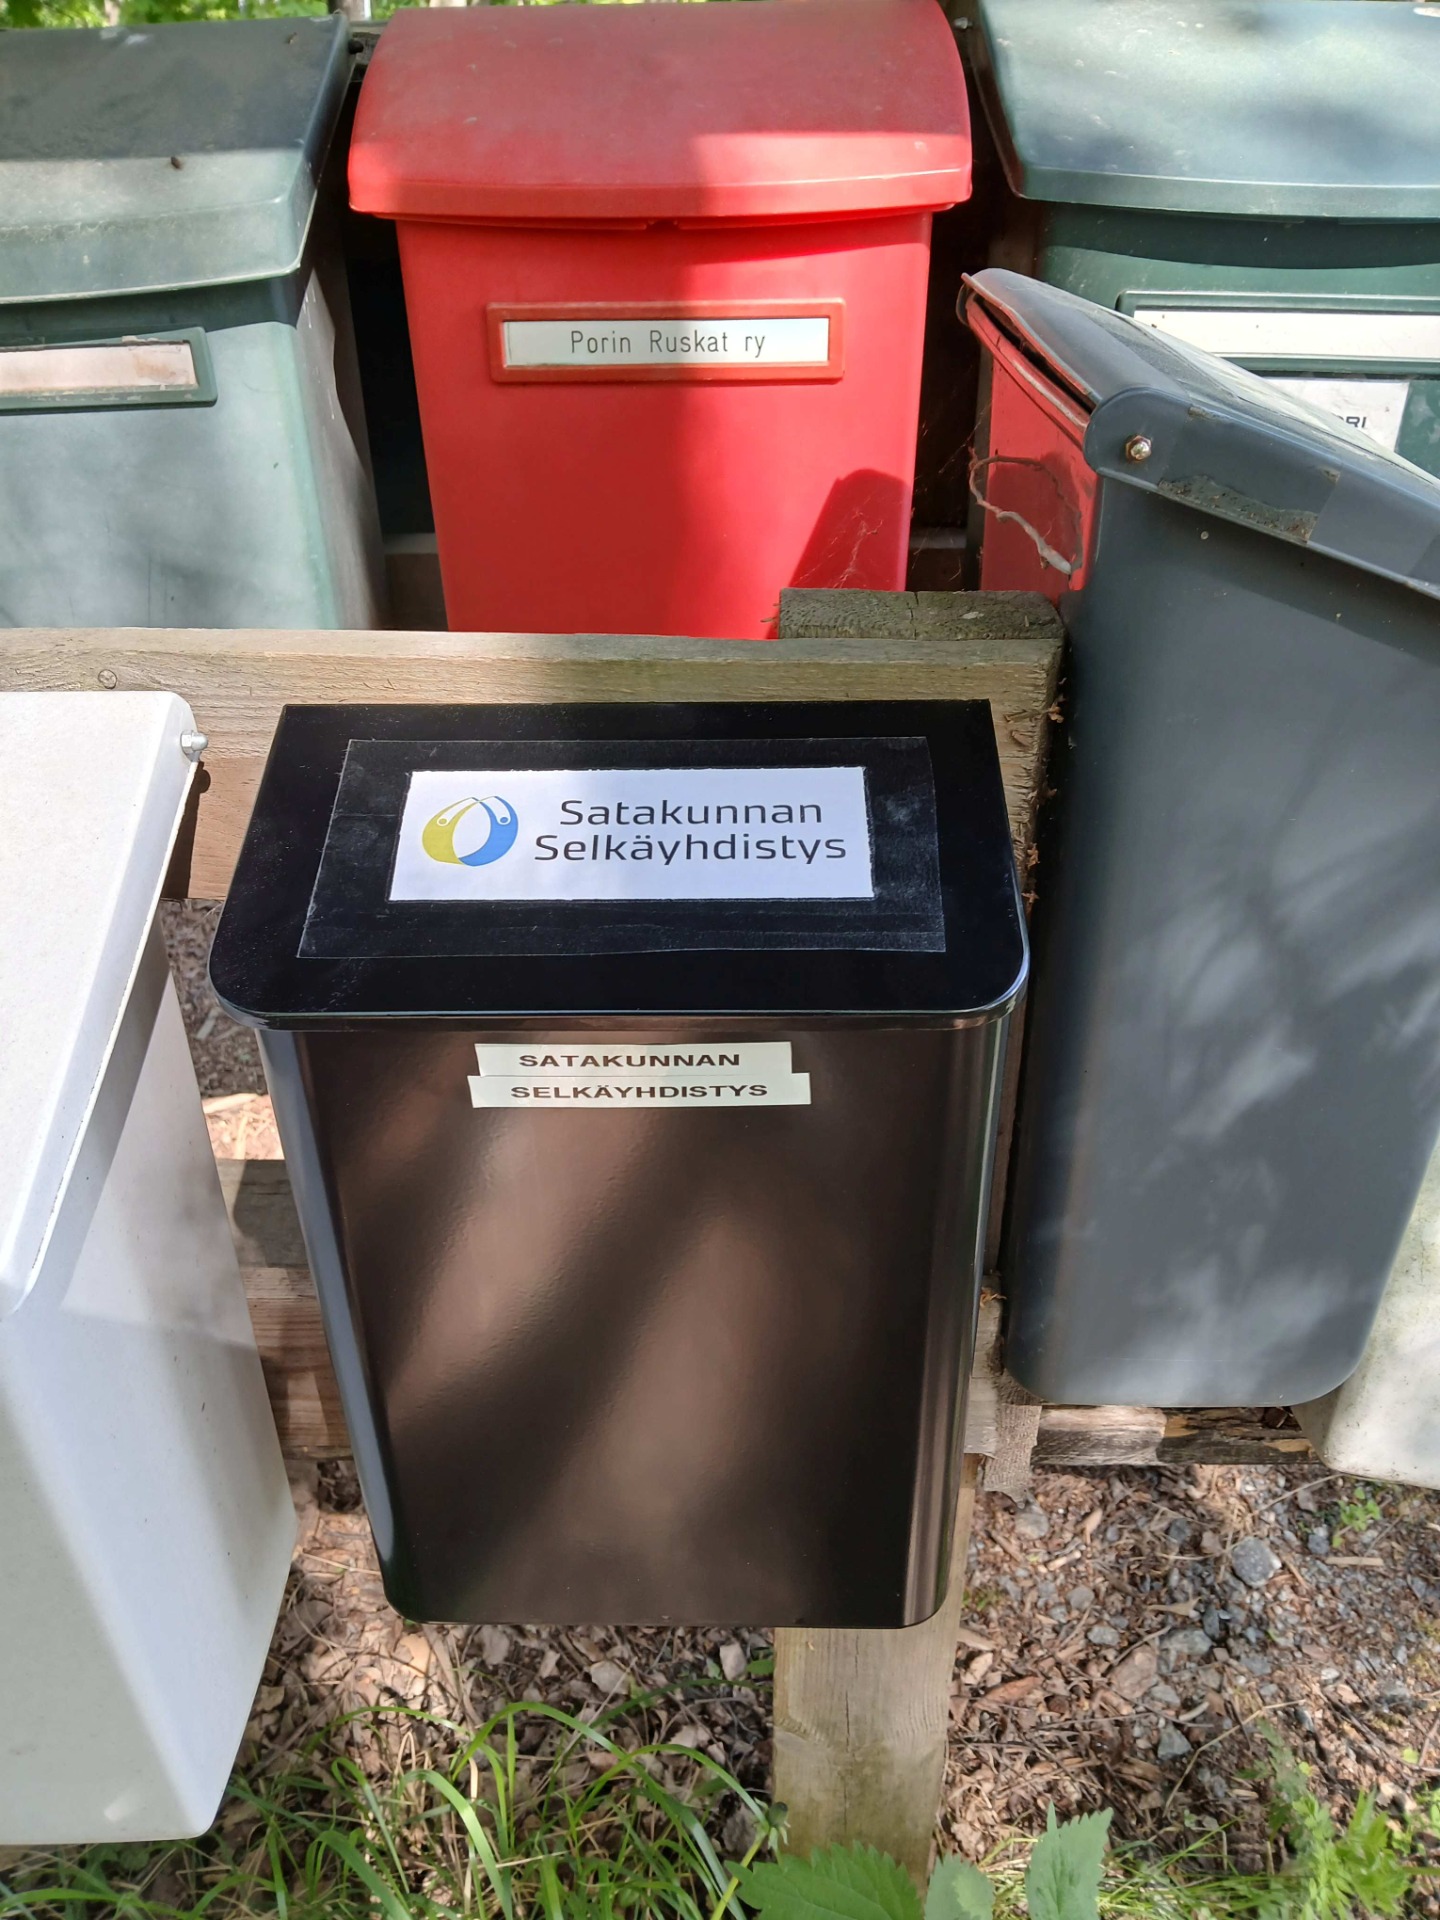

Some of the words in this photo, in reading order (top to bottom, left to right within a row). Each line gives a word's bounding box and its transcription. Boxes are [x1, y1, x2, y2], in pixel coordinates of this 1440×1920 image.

[570, 329, 632, 354] Porin
[649, 328, 729, 353] Ruskat
[744, 335, 766, 358] ry
[1337, 415, 1367, 429] RI
[560, 799, 822, 826] Satakunnan
[534, 833, 847, 866] Selkäyhdistys
[519, 1053, 740, 1068] SATAKUNNAN
[510, 1084, 768, 1099] SELKÄYHDISTYS
